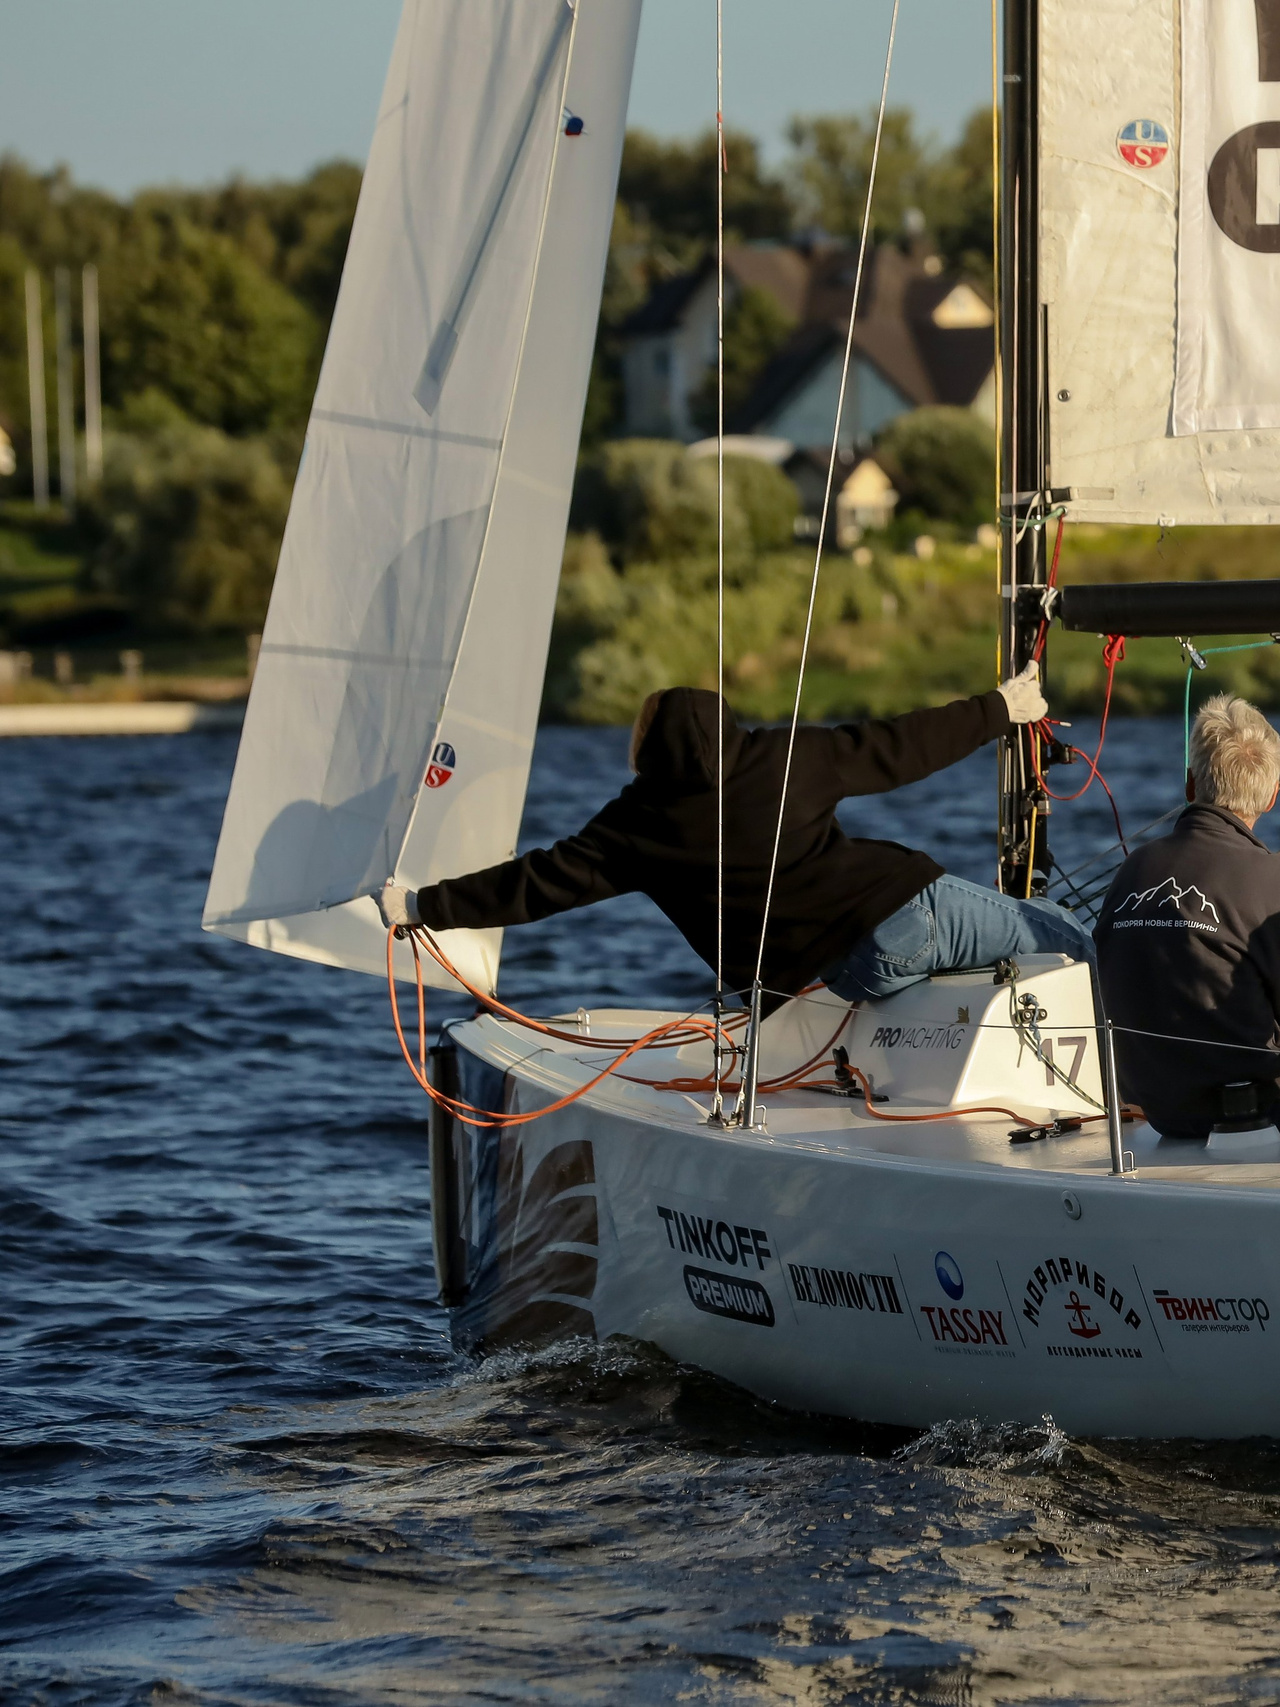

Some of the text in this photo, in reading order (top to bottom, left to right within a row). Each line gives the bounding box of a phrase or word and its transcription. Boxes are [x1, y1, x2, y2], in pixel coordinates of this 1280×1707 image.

[1112, 919, 1218, 933] ПОКОРЯЯ НОВЫЕ ВЕРШИНЫ
[869, 1026, 965, 1050] PROYACHTING
[1039, 1036, 1088, 1087] 17
[656, 1205, 772, 1271] TINKOFF
[687, 1274, 770, 1319] PREMIUM
[787, 1263, 904, 1315] ВЕДОМОСТИ
[1022, 1257, 1142, 1331] МОРПРИБОР
[920, 1305, 1009, 1346] TASSAY
[1046, 1345, 1144, 1359] ЛЕГЕНДАРНЫЕ ЧАСЫ
